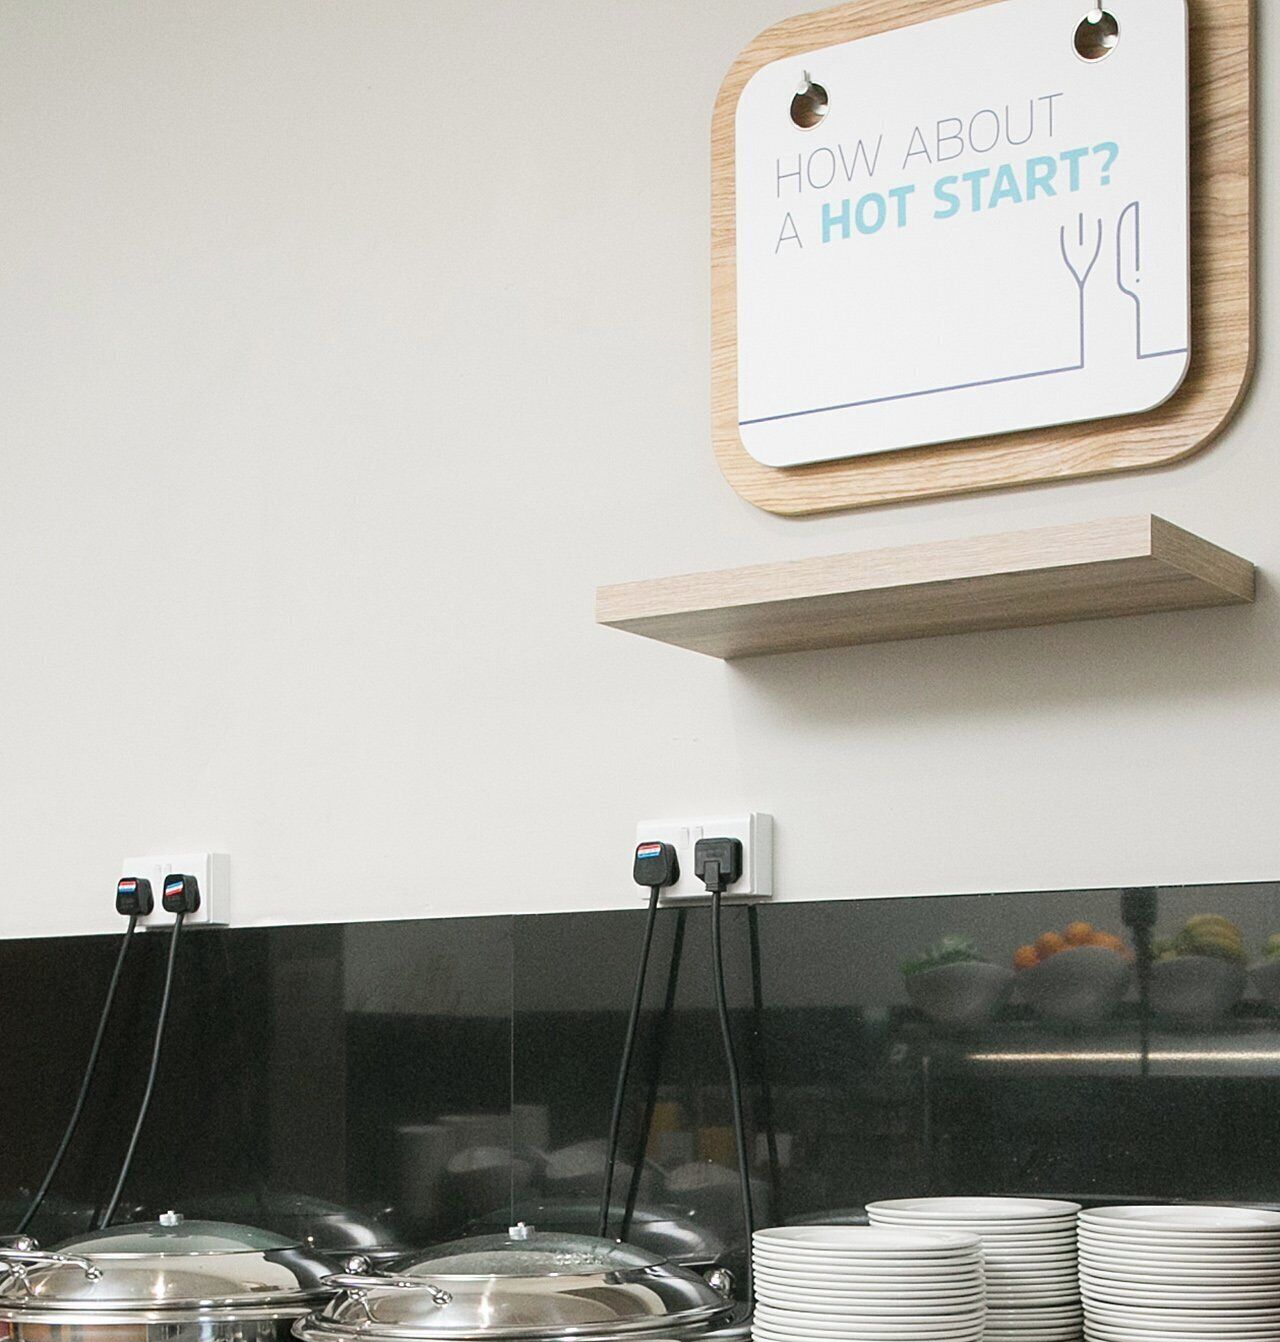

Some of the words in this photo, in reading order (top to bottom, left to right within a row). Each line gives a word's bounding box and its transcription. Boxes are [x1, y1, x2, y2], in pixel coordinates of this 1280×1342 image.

[775, 211, 804, 254] A
[821, 185, 916, 244] HOT
[933, 141, 1120, 220] START?
[776, 135, 883, 198] HOW
[902, 93, 1064, 170] ABOUT
